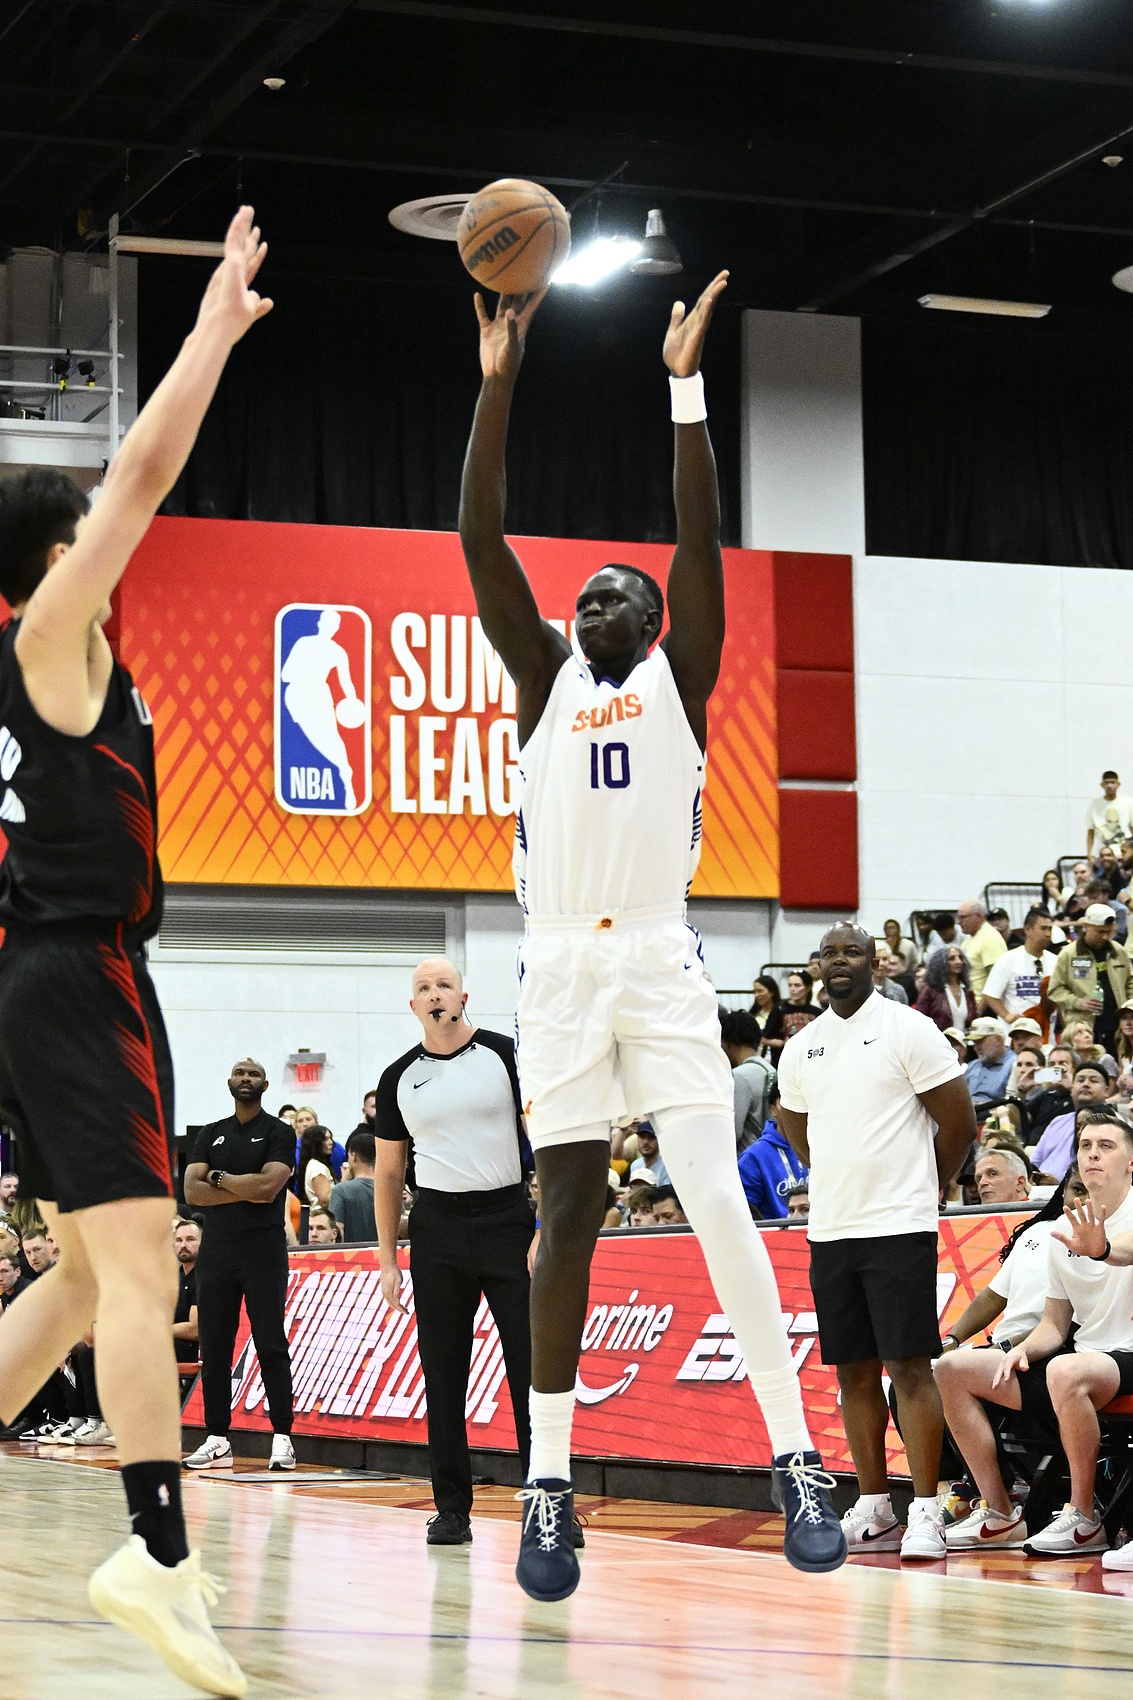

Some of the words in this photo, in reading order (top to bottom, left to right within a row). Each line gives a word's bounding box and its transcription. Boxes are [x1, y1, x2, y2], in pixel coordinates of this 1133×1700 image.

[290, 766, 336, 801] NBA
[390, 715, 519, 817] LEAG
[590, 742, 631, 789] 10
[297, 1063, 319, 1082] EXIT
